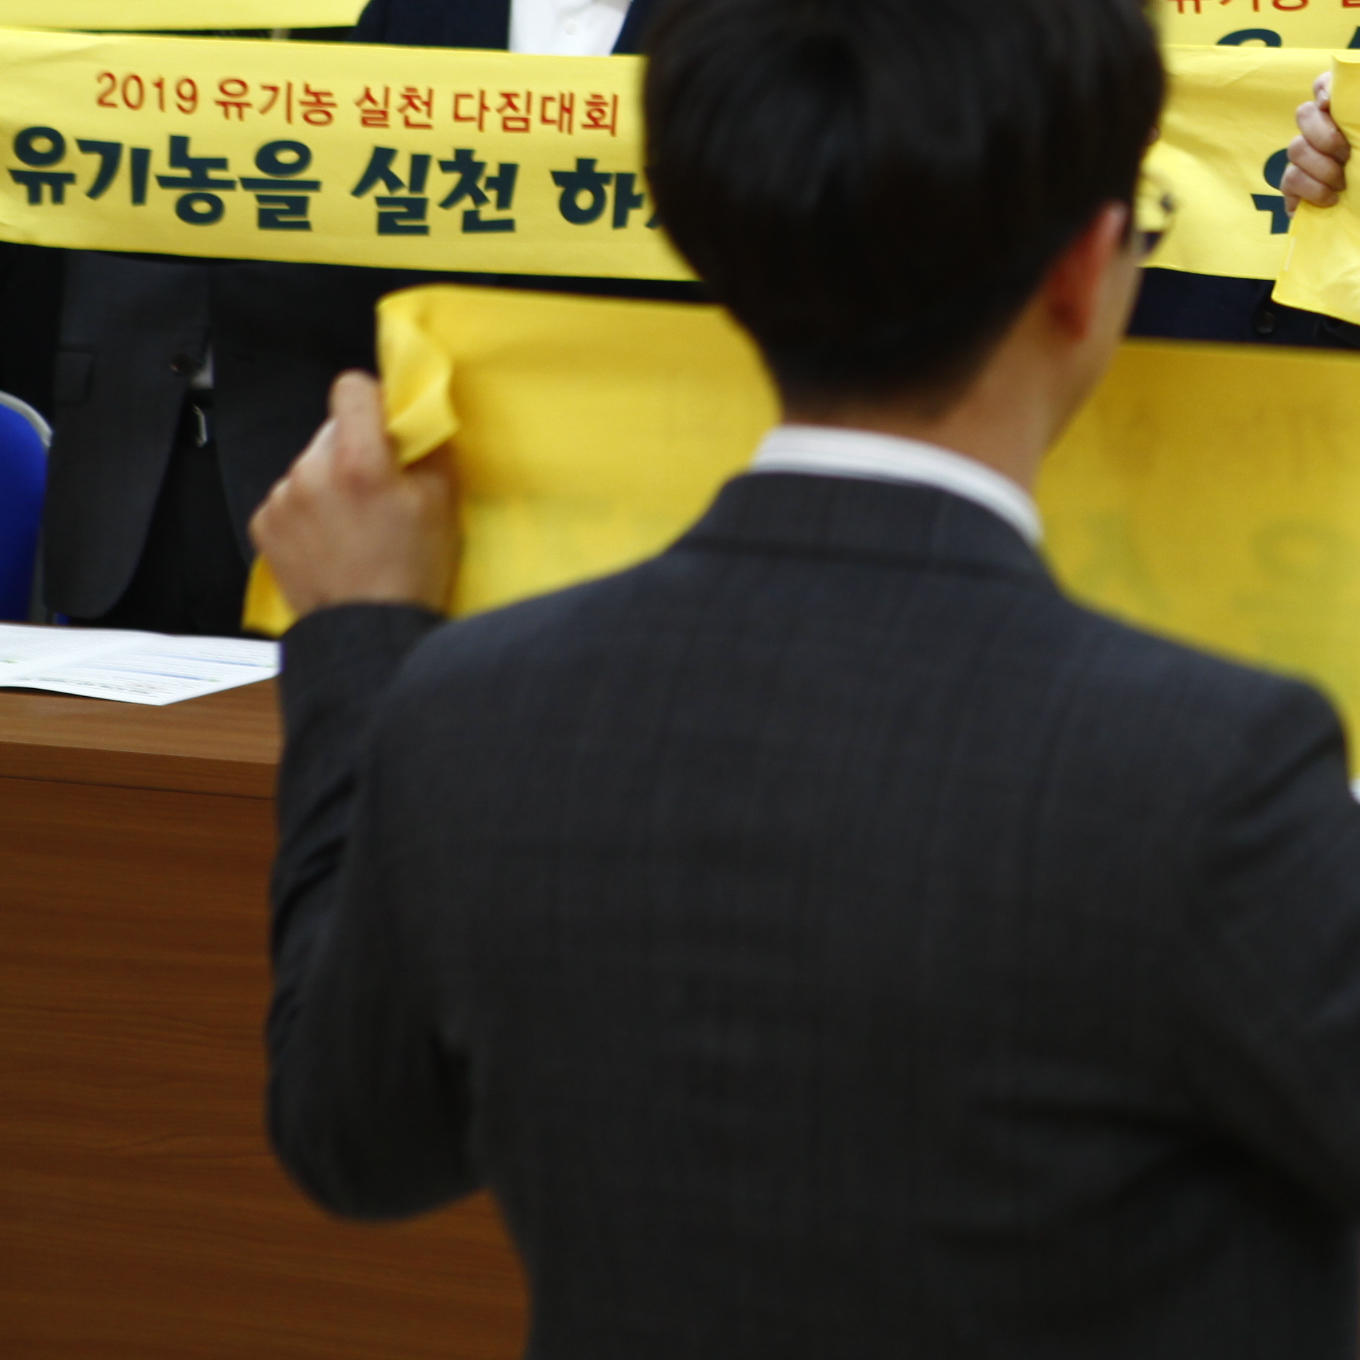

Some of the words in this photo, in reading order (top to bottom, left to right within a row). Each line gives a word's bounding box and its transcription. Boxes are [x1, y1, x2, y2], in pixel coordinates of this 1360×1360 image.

[95, 71, 198, 116] 2019
[213, 77, 339, 127] 유기농
[353, 84, 435, 132] 실천
[452, 89, 620, 138] 다짐대회
[7, 125, 322, 232] 유기농을
[351, 144, 520, 237] 실천
[550, 158, 664, 231] 하
